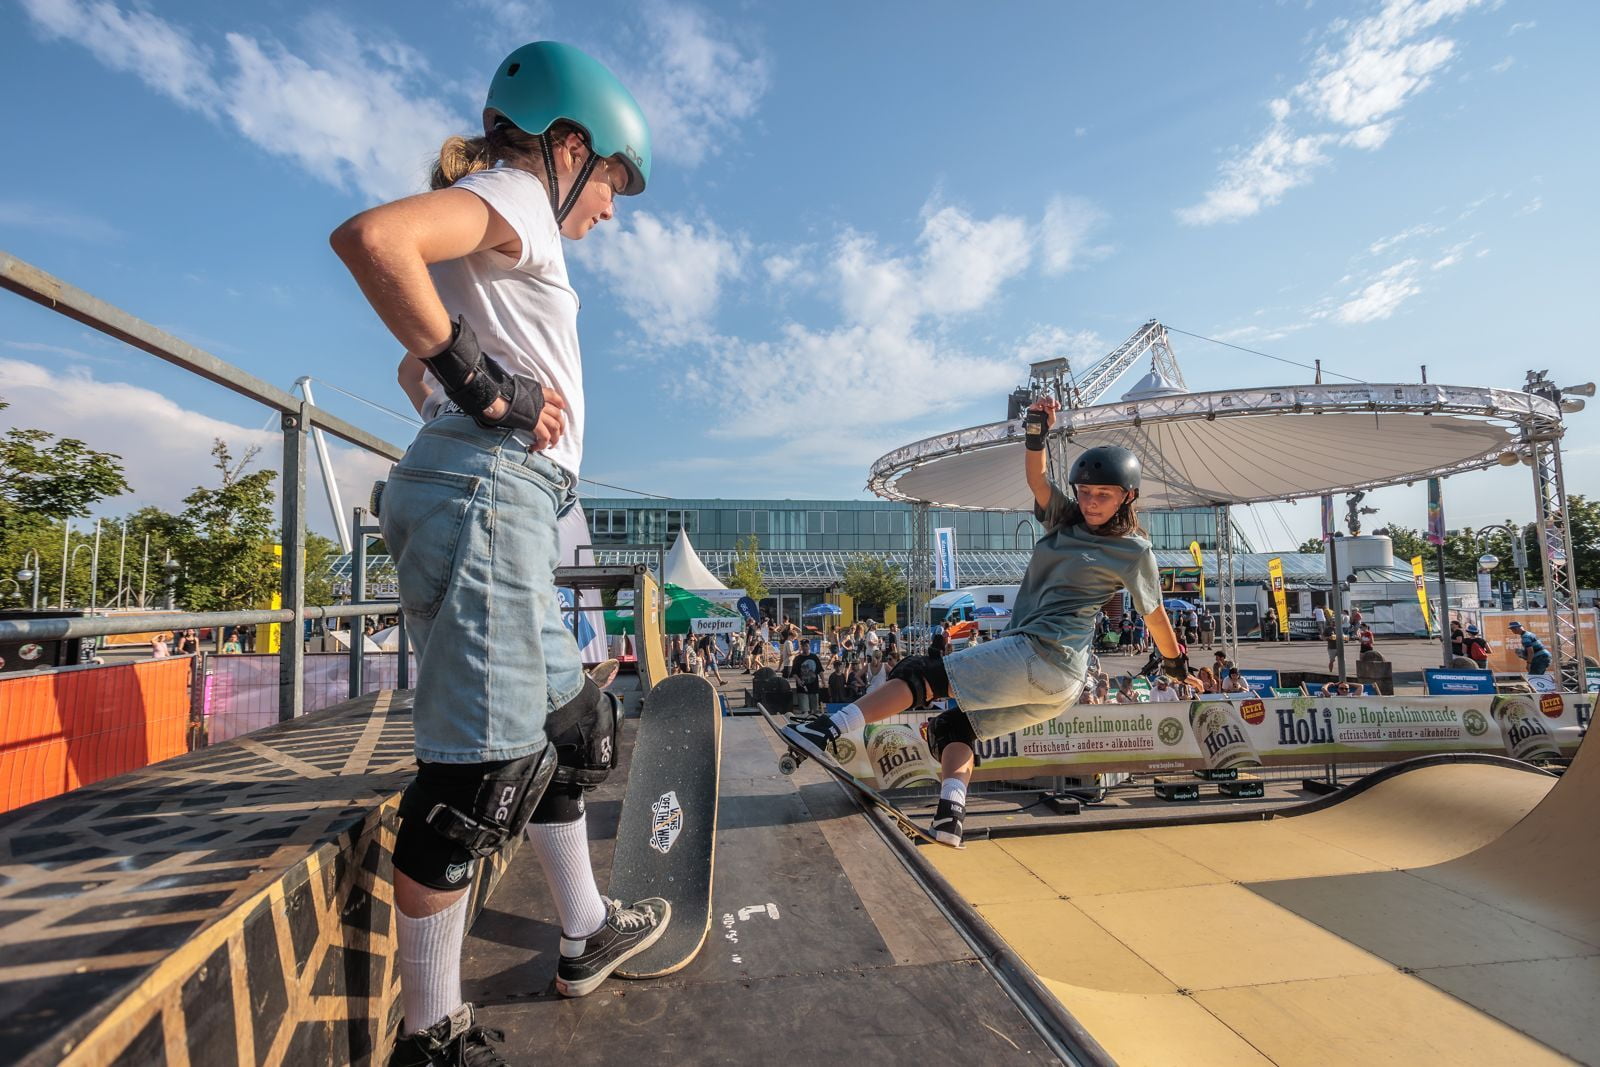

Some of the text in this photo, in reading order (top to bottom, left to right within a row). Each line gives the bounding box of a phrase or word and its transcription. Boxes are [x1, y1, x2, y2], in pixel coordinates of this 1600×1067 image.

[1048, 713, 1153, 738] Hopfenlimonade
[1276, 706, 1335, 746] HoLi
[1336, 706, 1357, 725] Die
[1358, 705, 1458, 727] Hopfenlimonade
[1023, 736, 1155, 754] erfrischend anders alkoholfrei
[1204, 724, 1246, 759] HoLi
[1339, 726, 1461, 741] erfrischend anders alkoholfrei
[1508, 717, 1548, 750] HoLi
[877, 746, 923, 779] HoLi
[656, 810, 670, 828] THE
